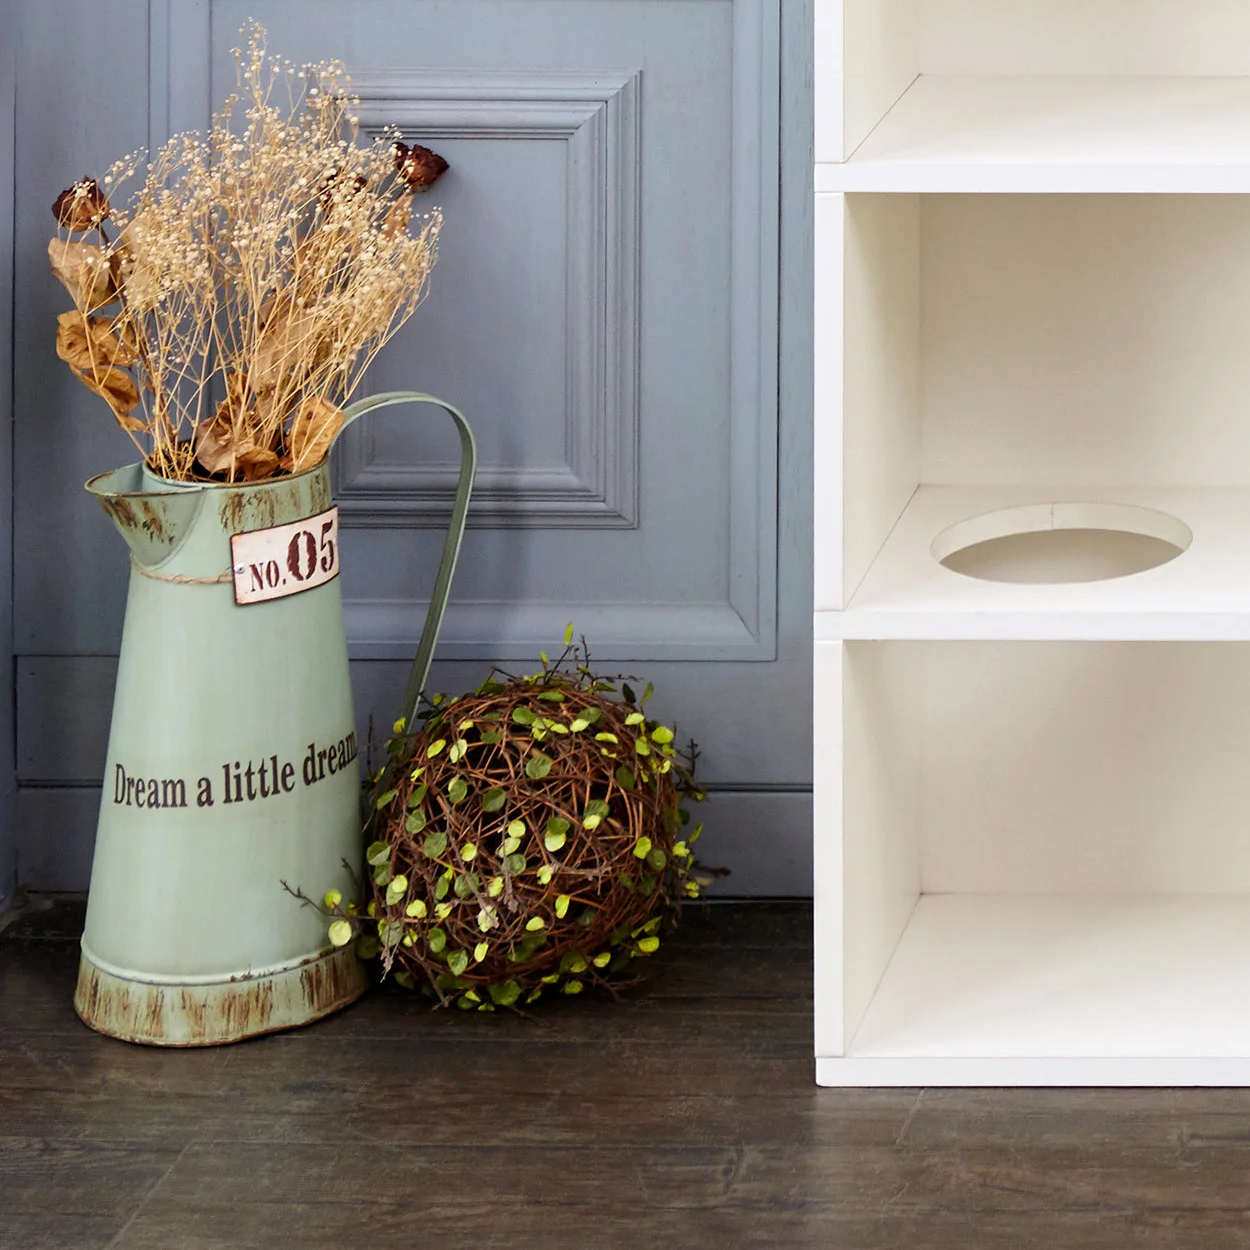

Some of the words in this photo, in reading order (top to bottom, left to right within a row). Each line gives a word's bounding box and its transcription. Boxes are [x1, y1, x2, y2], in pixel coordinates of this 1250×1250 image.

[287, 519, 334, 581] 05
[113, 763, 188, 809] Dream
[196, 775, 215, 807] a
[222, 754, 295, 804] little
[302, 731, 357, 786] dream
